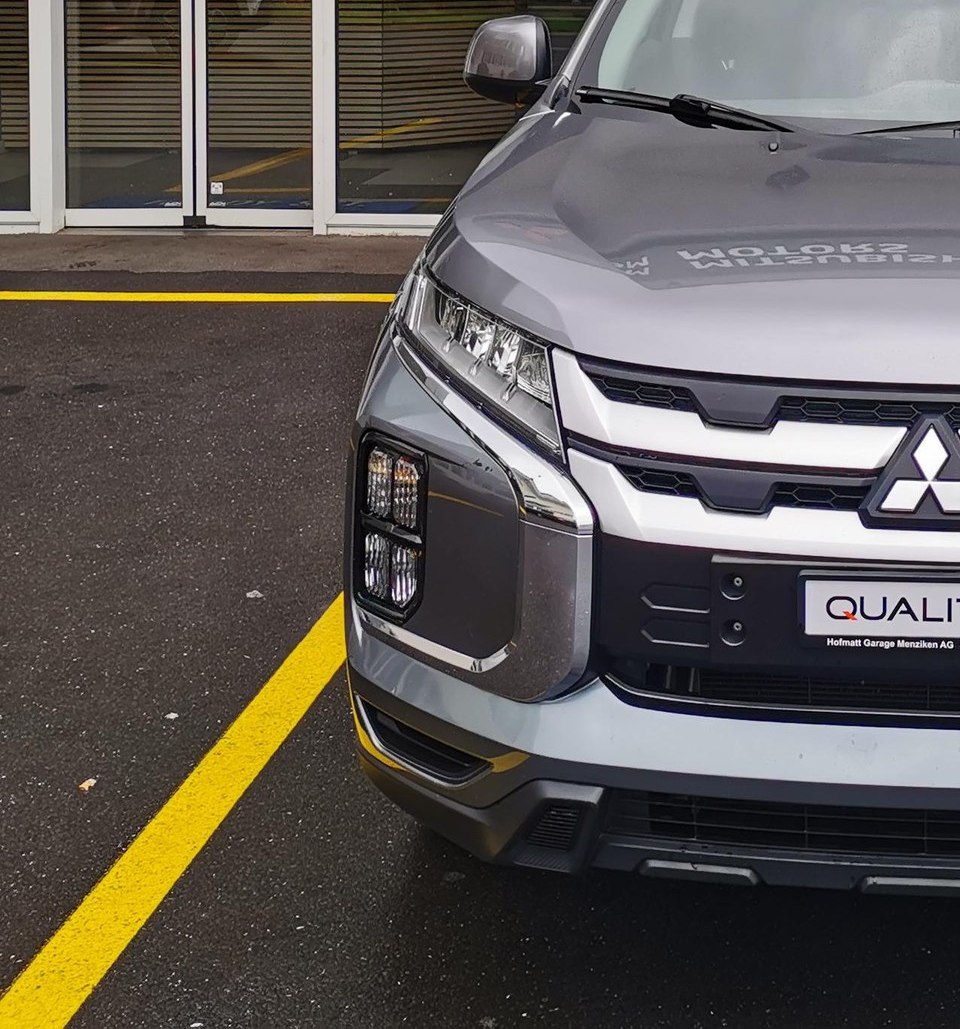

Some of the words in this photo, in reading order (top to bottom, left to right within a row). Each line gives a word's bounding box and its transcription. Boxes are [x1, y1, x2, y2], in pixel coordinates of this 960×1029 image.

[827, 638, 862, 647] Hofmatt
[864, 639, 895, 649] Garage
[897, 640, 938, 649] Menziken
[940, 641, 954, 649] AG
